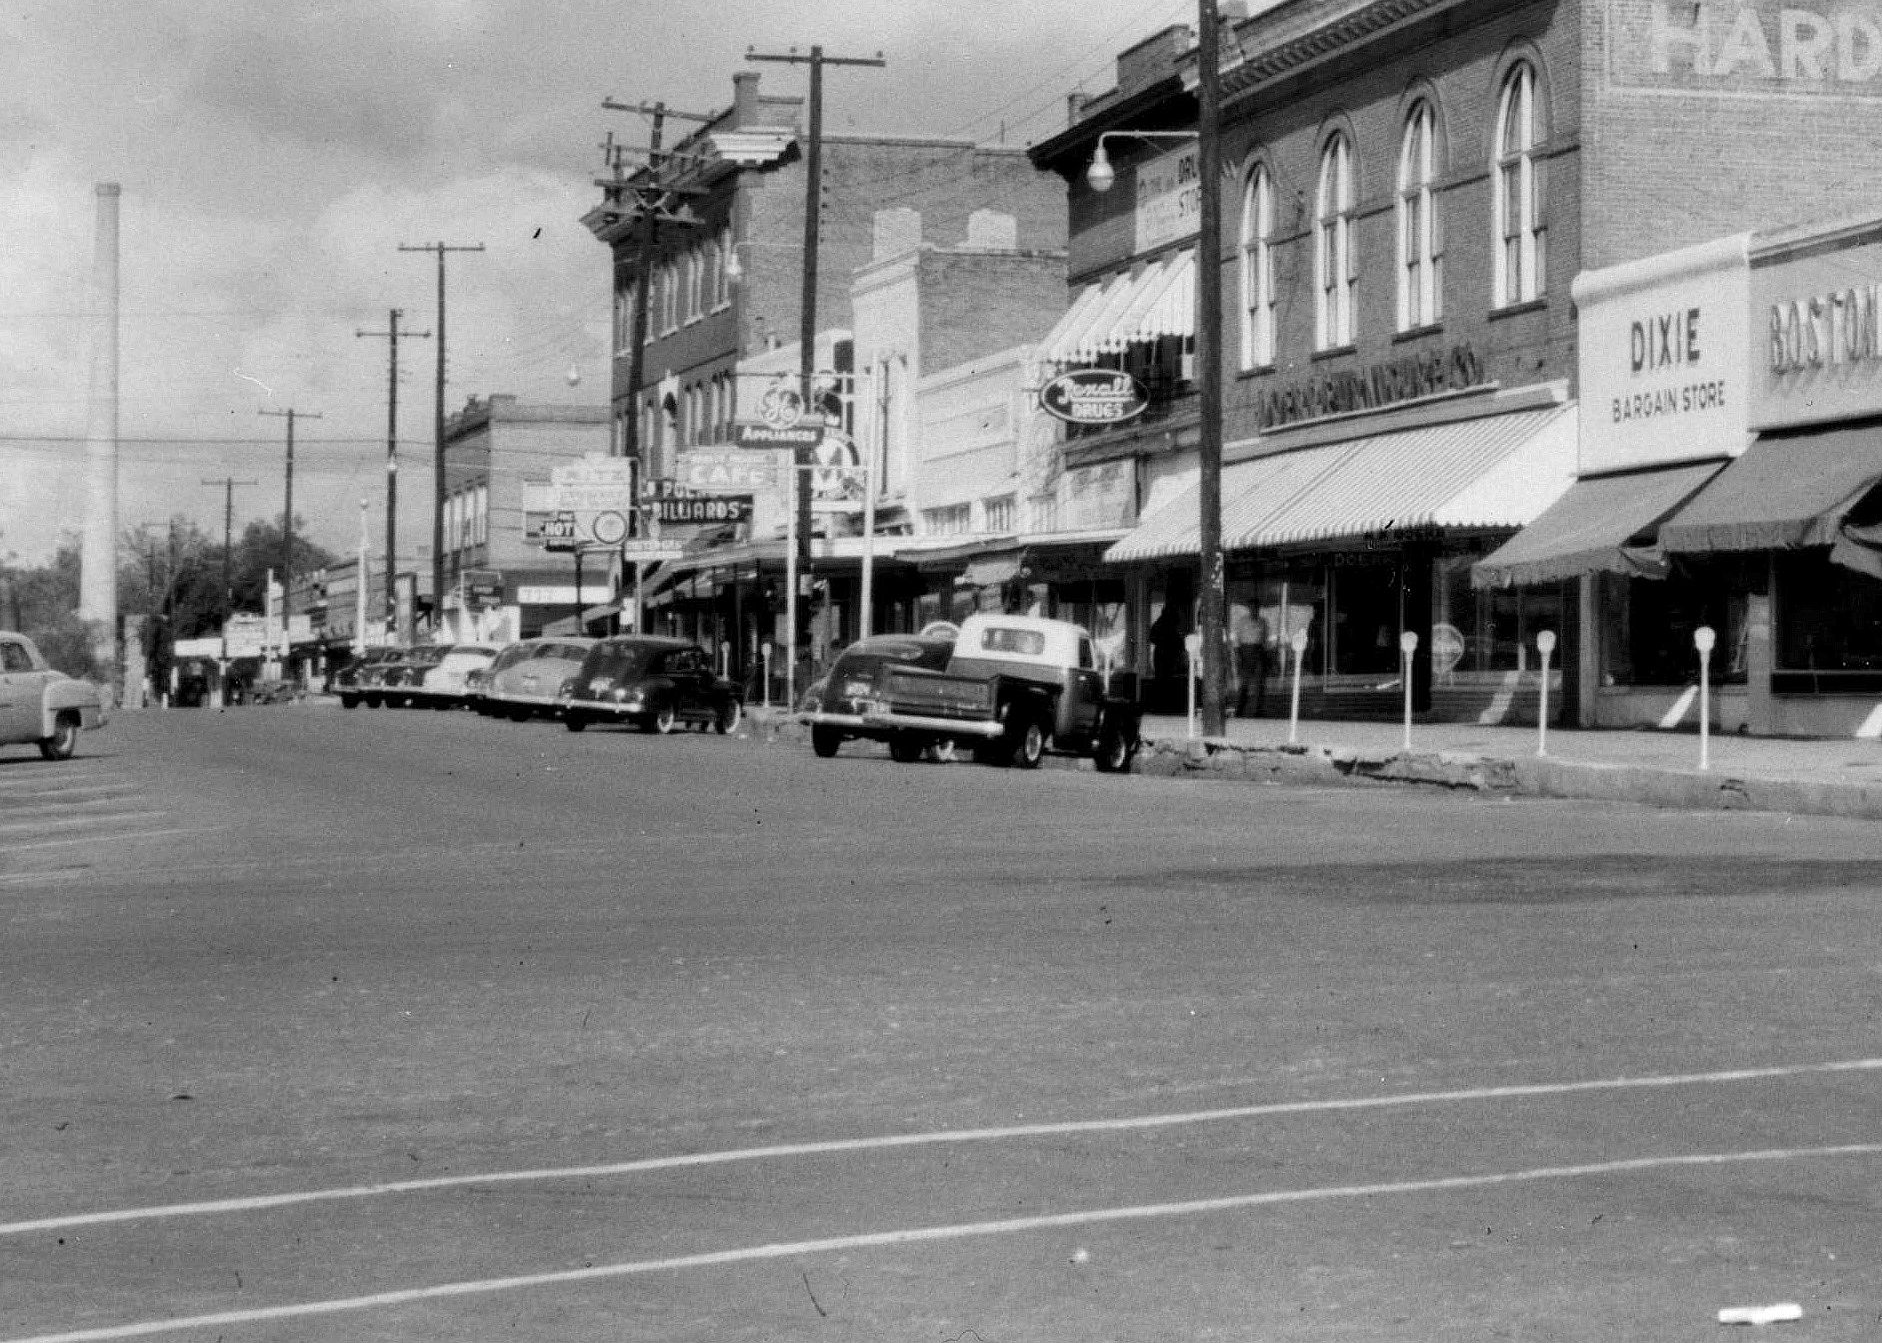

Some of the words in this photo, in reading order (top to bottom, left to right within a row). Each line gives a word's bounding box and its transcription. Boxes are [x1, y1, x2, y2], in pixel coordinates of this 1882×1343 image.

[1631, 307, 1701, 372] DIXIE
[1057, 376, 1135, 405] Rexall
[1611, 389, 1677, 424] BARGAIN
[1682, 380, 1725, 411] STORE
[1071, 402, 1123, 418] DRUGS
[652, 500, 741, 520] BILLIARDS
